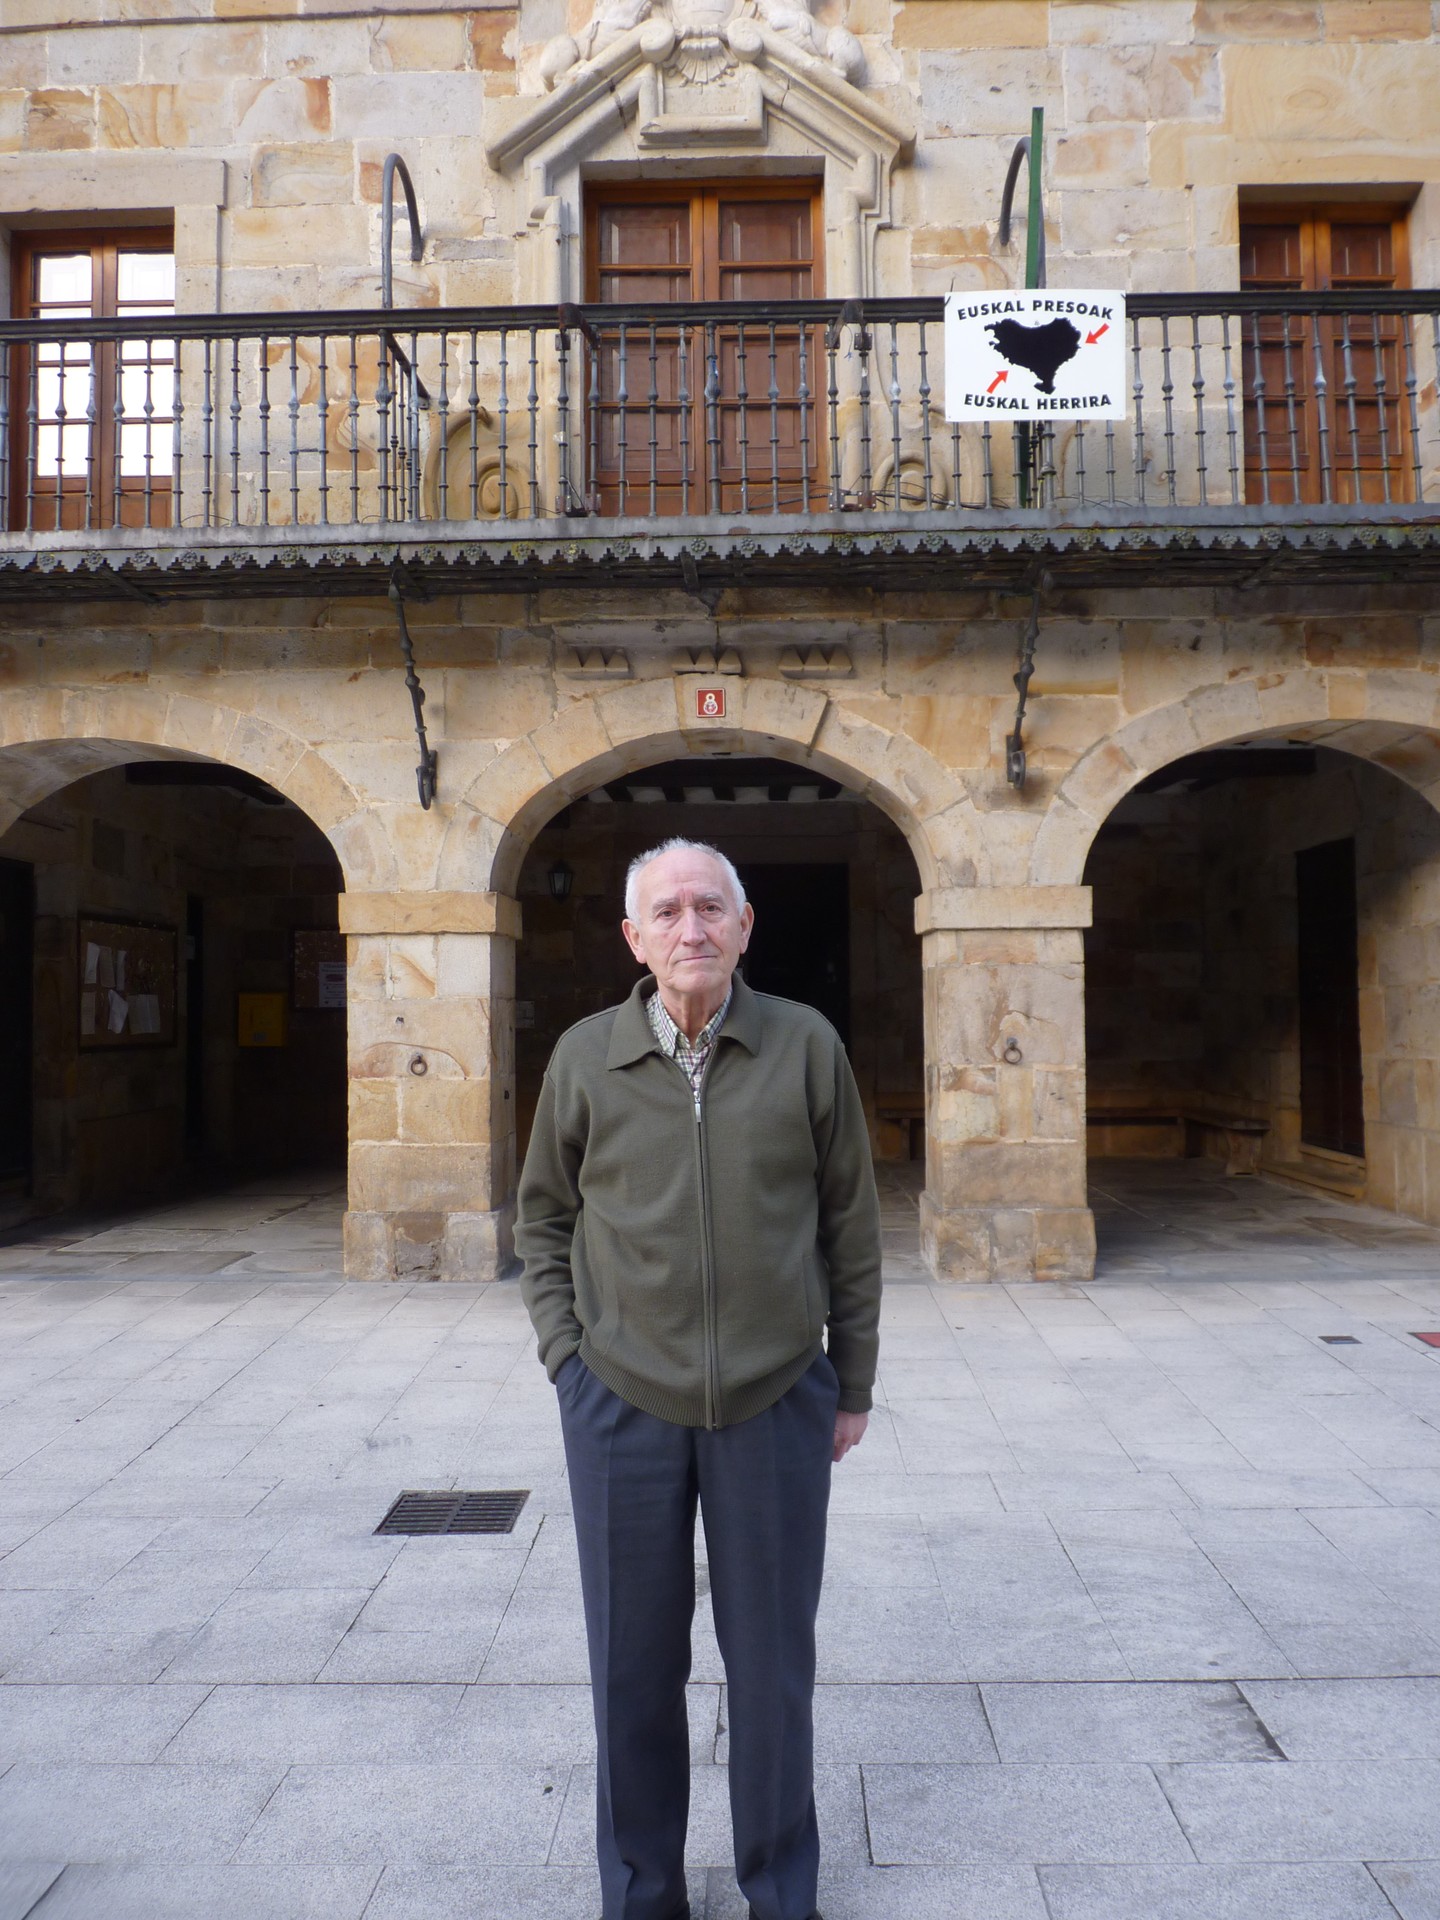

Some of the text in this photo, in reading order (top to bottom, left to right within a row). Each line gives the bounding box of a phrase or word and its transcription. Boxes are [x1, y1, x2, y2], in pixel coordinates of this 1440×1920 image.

[957, 300, 1113, 320] EUSKAL PRESOAK
[964, 394, 1112, 410] EUSKAL HERRIRA
[703, 693, 718, 714] 8
